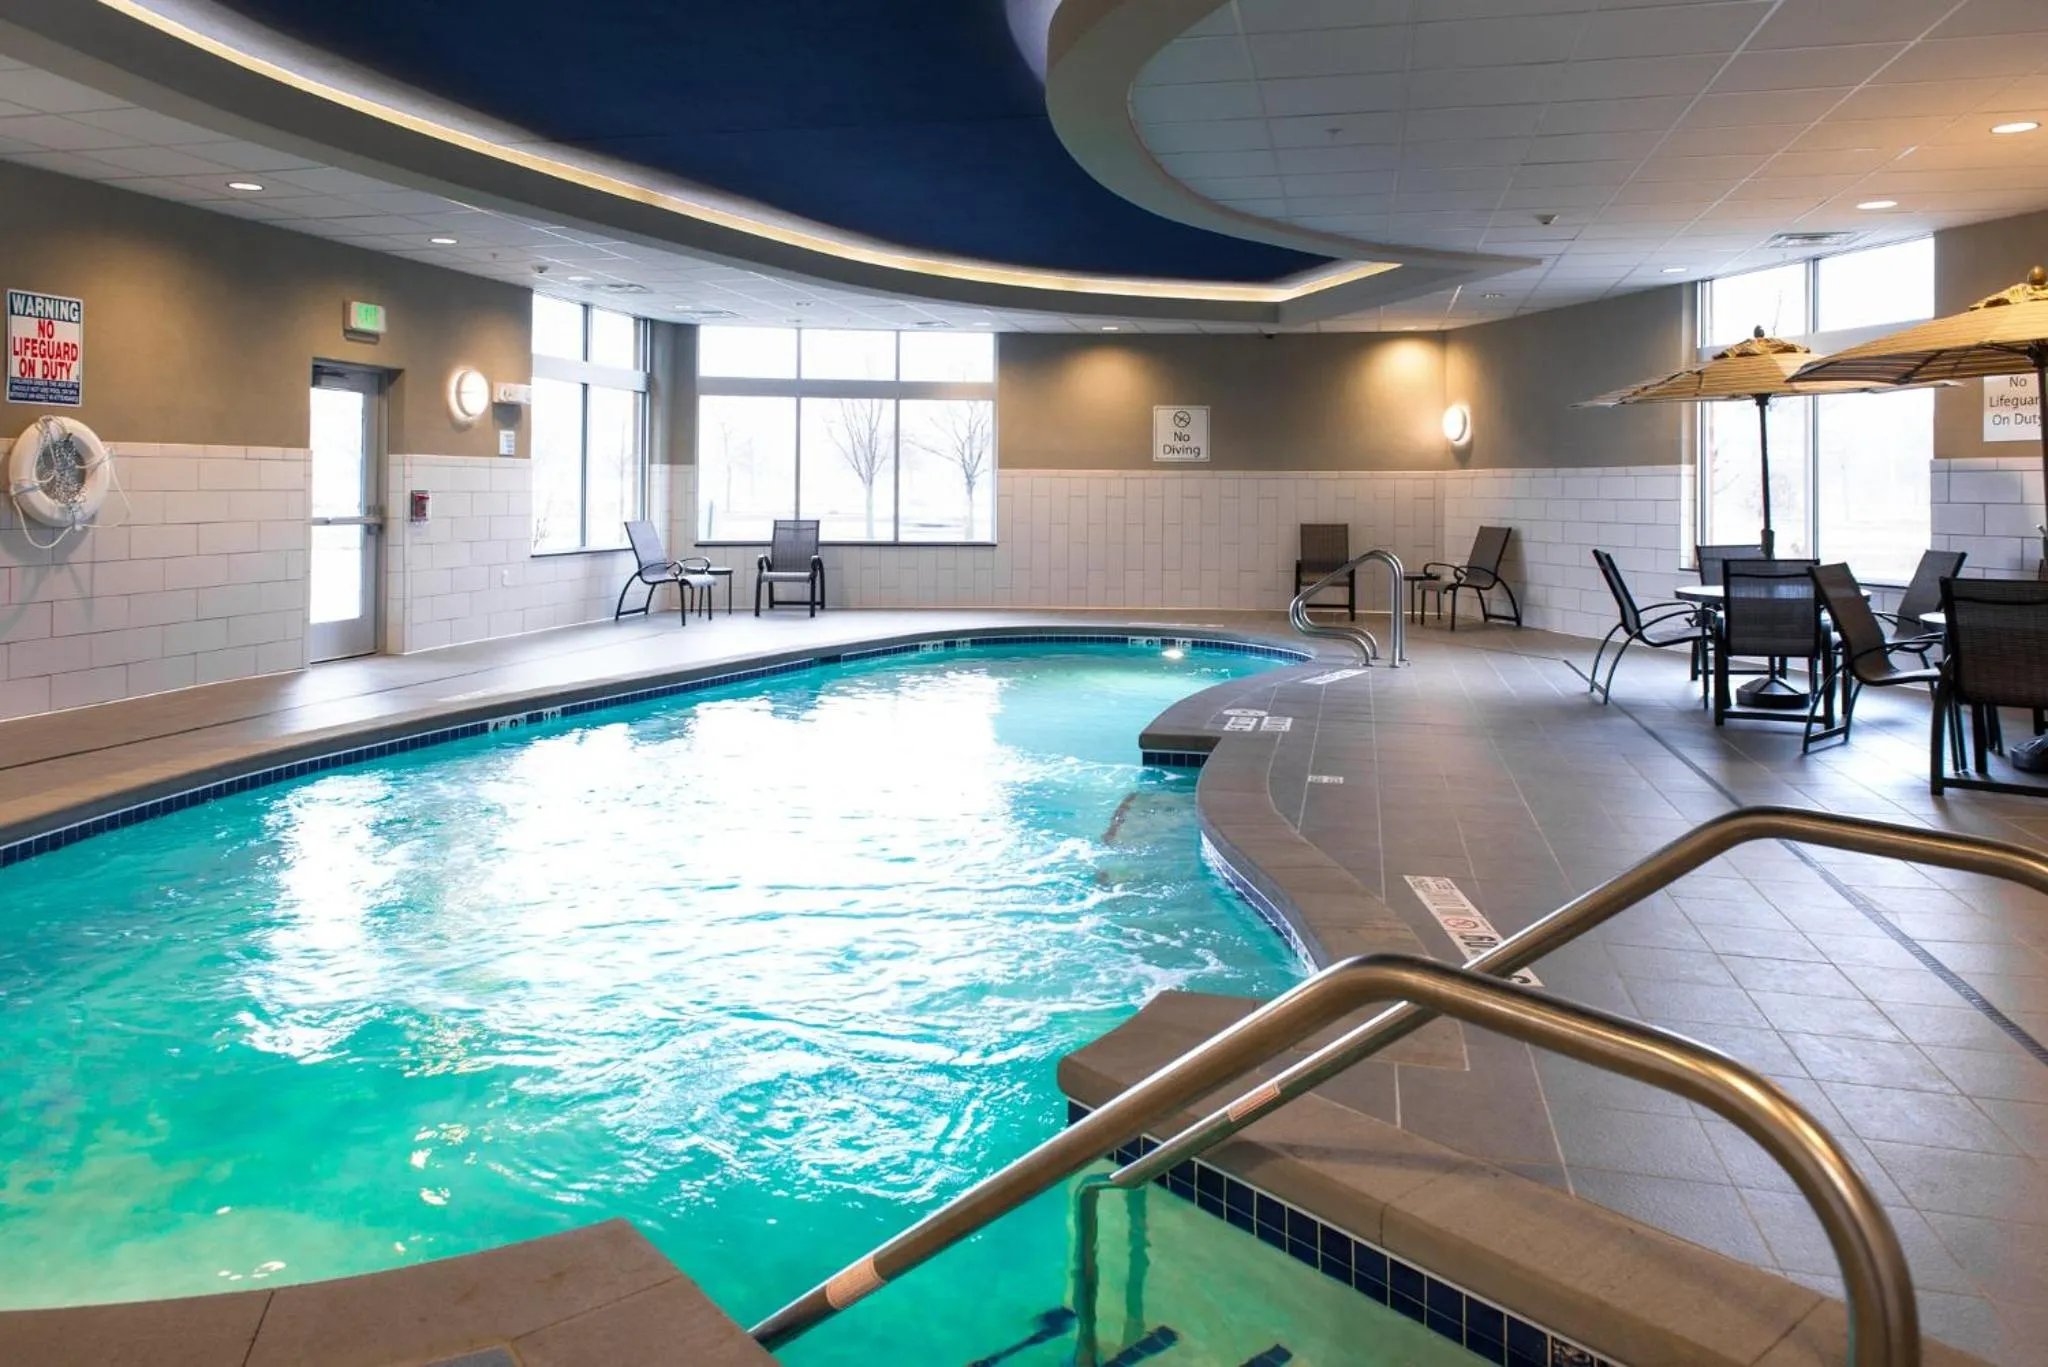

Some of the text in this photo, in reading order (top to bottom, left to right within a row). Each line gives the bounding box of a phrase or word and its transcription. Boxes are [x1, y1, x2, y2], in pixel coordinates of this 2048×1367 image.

[11, 293, 79, 322] WARNING
[37, 319, 54, 339] NO
[12, 336, 78, 362] LIFEGUARD
[19, 358, 72, 380] ON DUTY
[2009, 376, 2027, 387] No
[1989, 394, 2039, 409] Lifeguar
[1992, 414, 2010, 426] On
[1173, 431, 1191, 442] No
[1162, 444, 1201, 458] Diving
